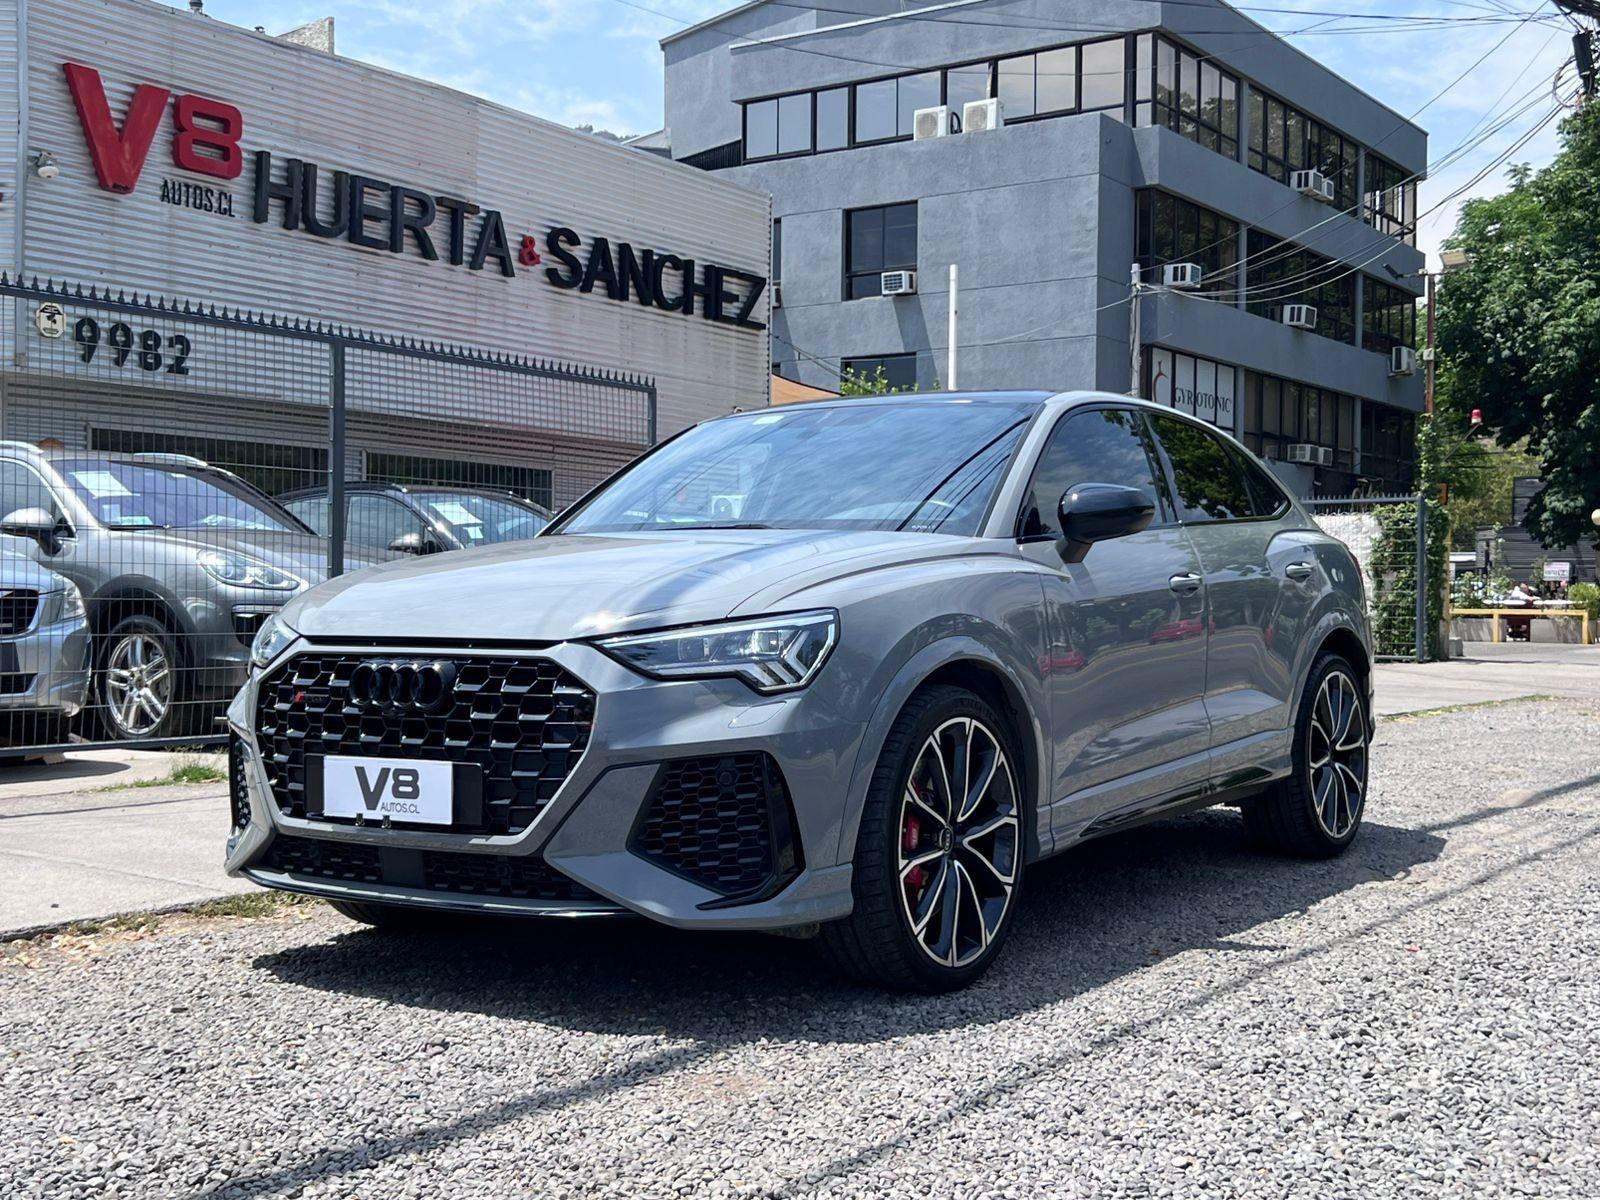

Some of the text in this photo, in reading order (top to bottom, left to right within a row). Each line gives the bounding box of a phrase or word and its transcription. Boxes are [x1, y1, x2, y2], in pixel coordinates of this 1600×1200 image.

[63, 62, 243, 195] V8
[160, 178, 236, 218] AUTOS.CL
[253, 150, 767, 330] HUERTA & SANCHEZ
[74, 316, 191, 376] 9982
[354, 766, 420, 810] V8
[381, 802, 420, 814] AUTOS.CL
